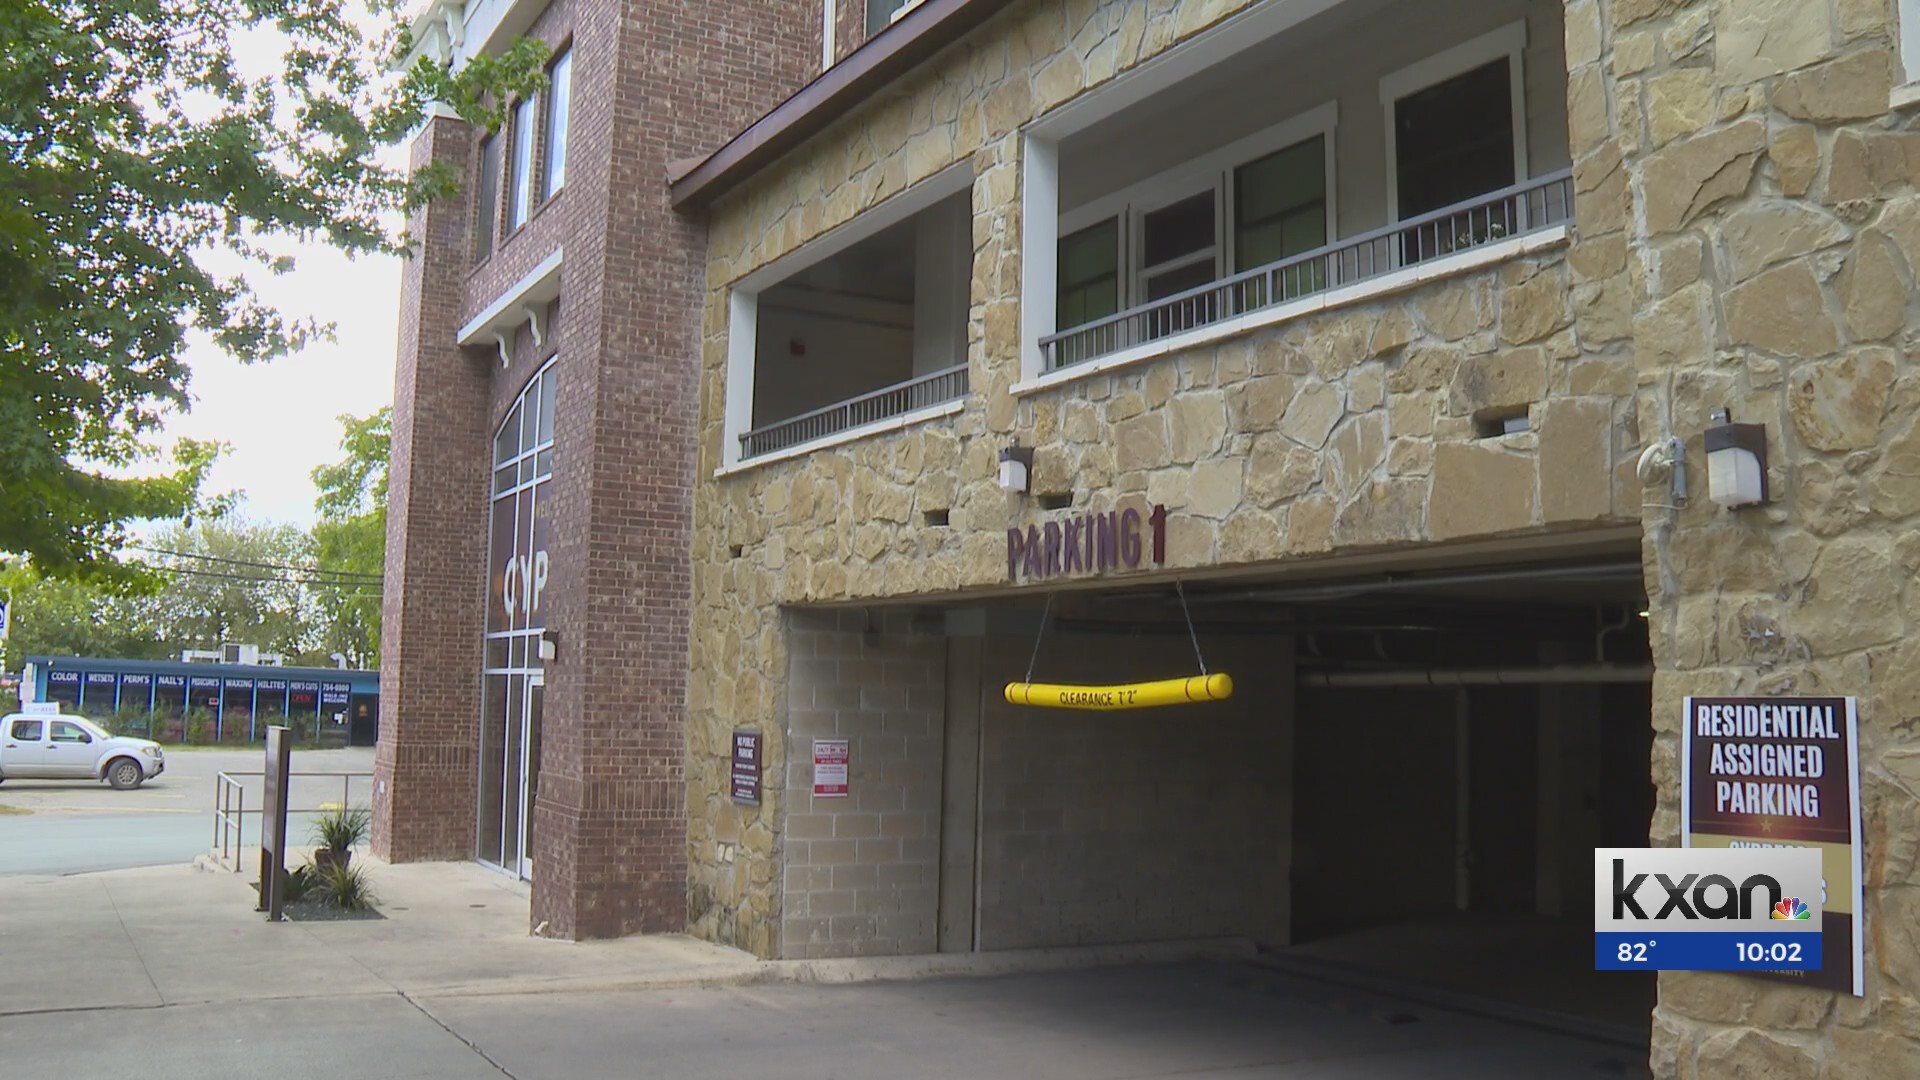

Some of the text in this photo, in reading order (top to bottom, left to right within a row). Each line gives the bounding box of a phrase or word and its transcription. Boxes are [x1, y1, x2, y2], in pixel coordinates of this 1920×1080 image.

[1007, 503, 1167, 582] PARKING 1
[51, 672, 79, 682] COLOR
[123, 674, 150, 684] PERM'S
[158, 676, 185, 686] NAIL'S
[225, 679, 253, 689] WAXING
[258, 681, 286, 690] HILITES
[1060, 691, 1114, 706] CLEARANCE
[1697, 705, 1840, 739] RESIDENTIAL
[1710, 743, 1823, 778] ASSIGNED
[1716, 781, 1819, 818] PARKING
